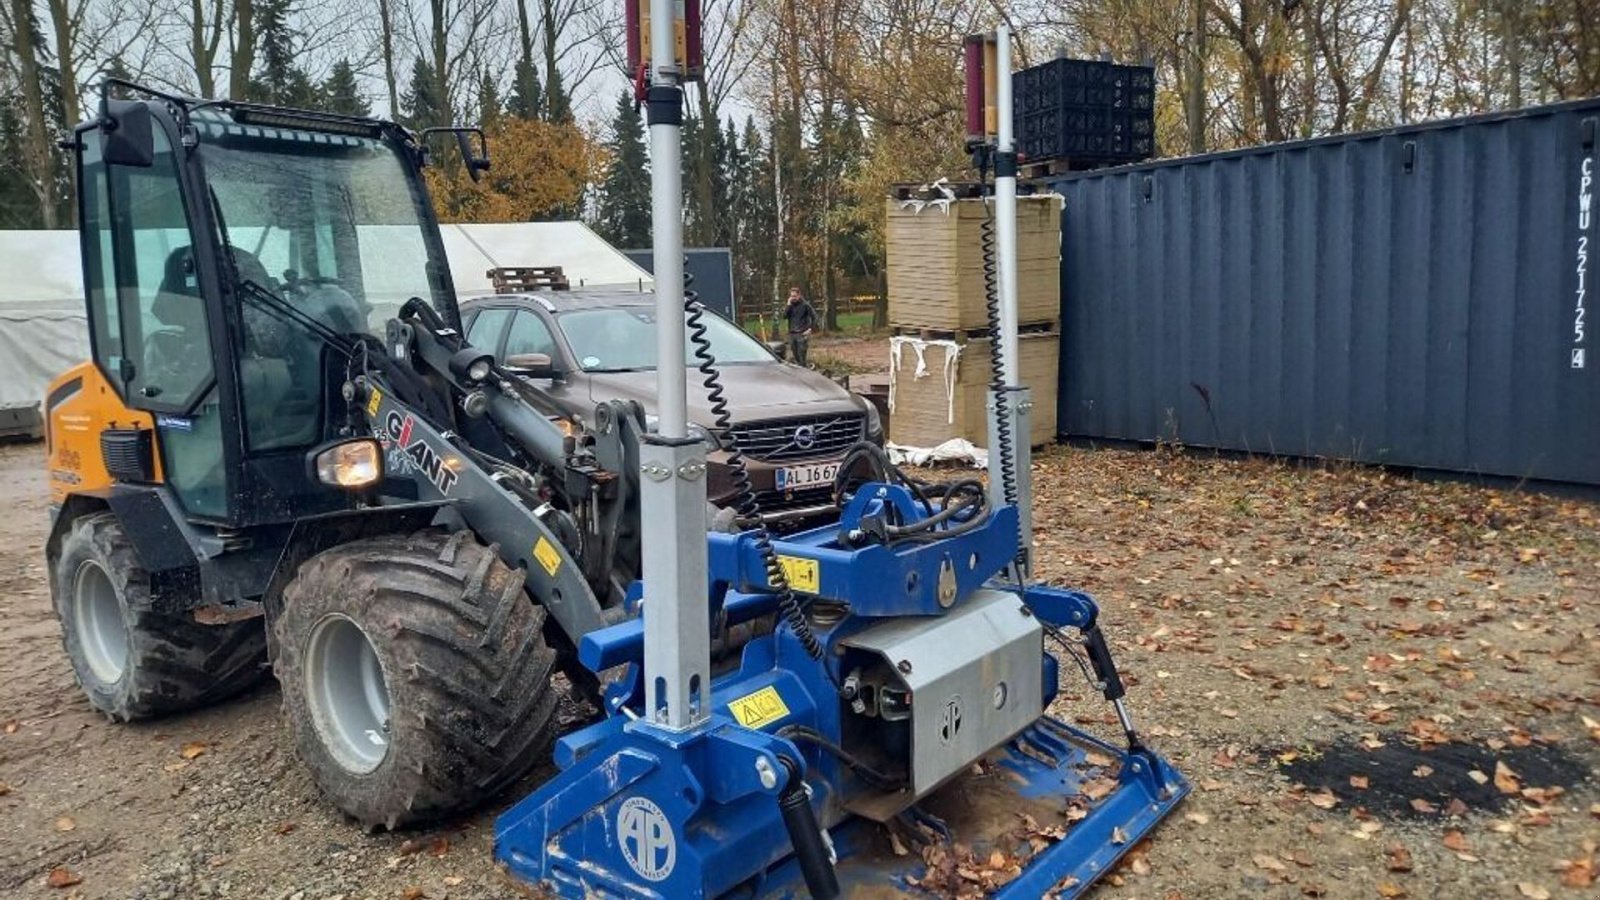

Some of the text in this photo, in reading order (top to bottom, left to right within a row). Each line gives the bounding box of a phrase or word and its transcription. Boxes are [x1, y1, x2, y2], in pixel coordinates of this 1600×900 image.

[1572, 158, 1592, 368] CPWU 221725 4
[786, 465, 838, 485] AL 16 67
